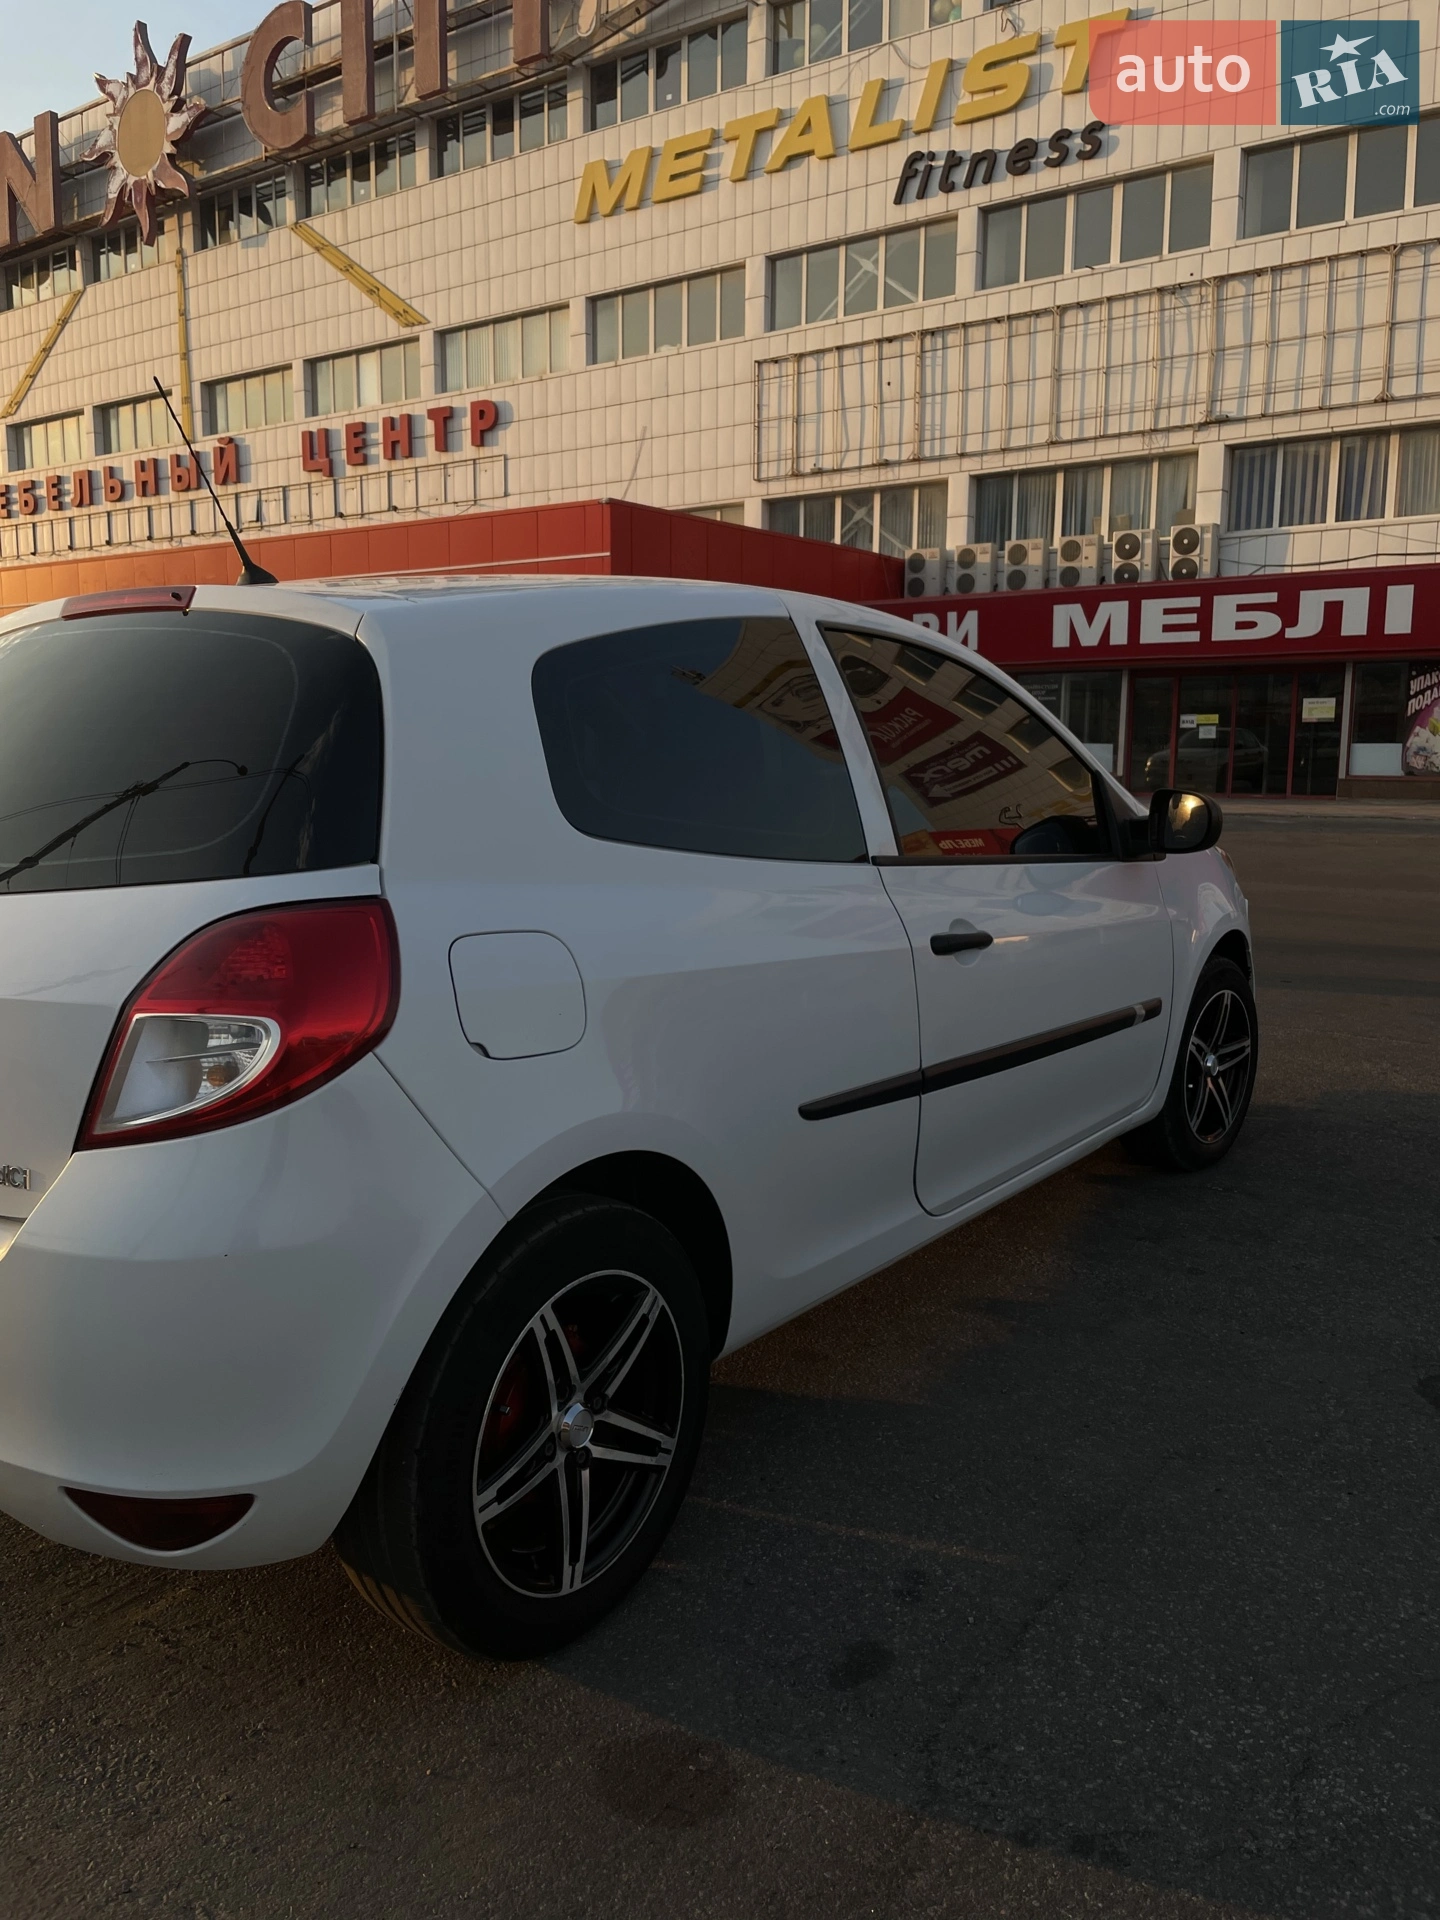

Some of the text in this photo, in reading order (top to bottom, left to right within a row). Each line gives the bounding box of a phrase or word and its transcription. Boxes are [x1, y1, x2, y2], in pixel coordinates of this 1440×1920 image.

[574, 7, 1131, 224] METALIST
[892, 119, 1105, 205] fitness
[301, 399, 498, 478] ЦЕНТР
[1051, 584, 1416, 648] МЕБЛІ
